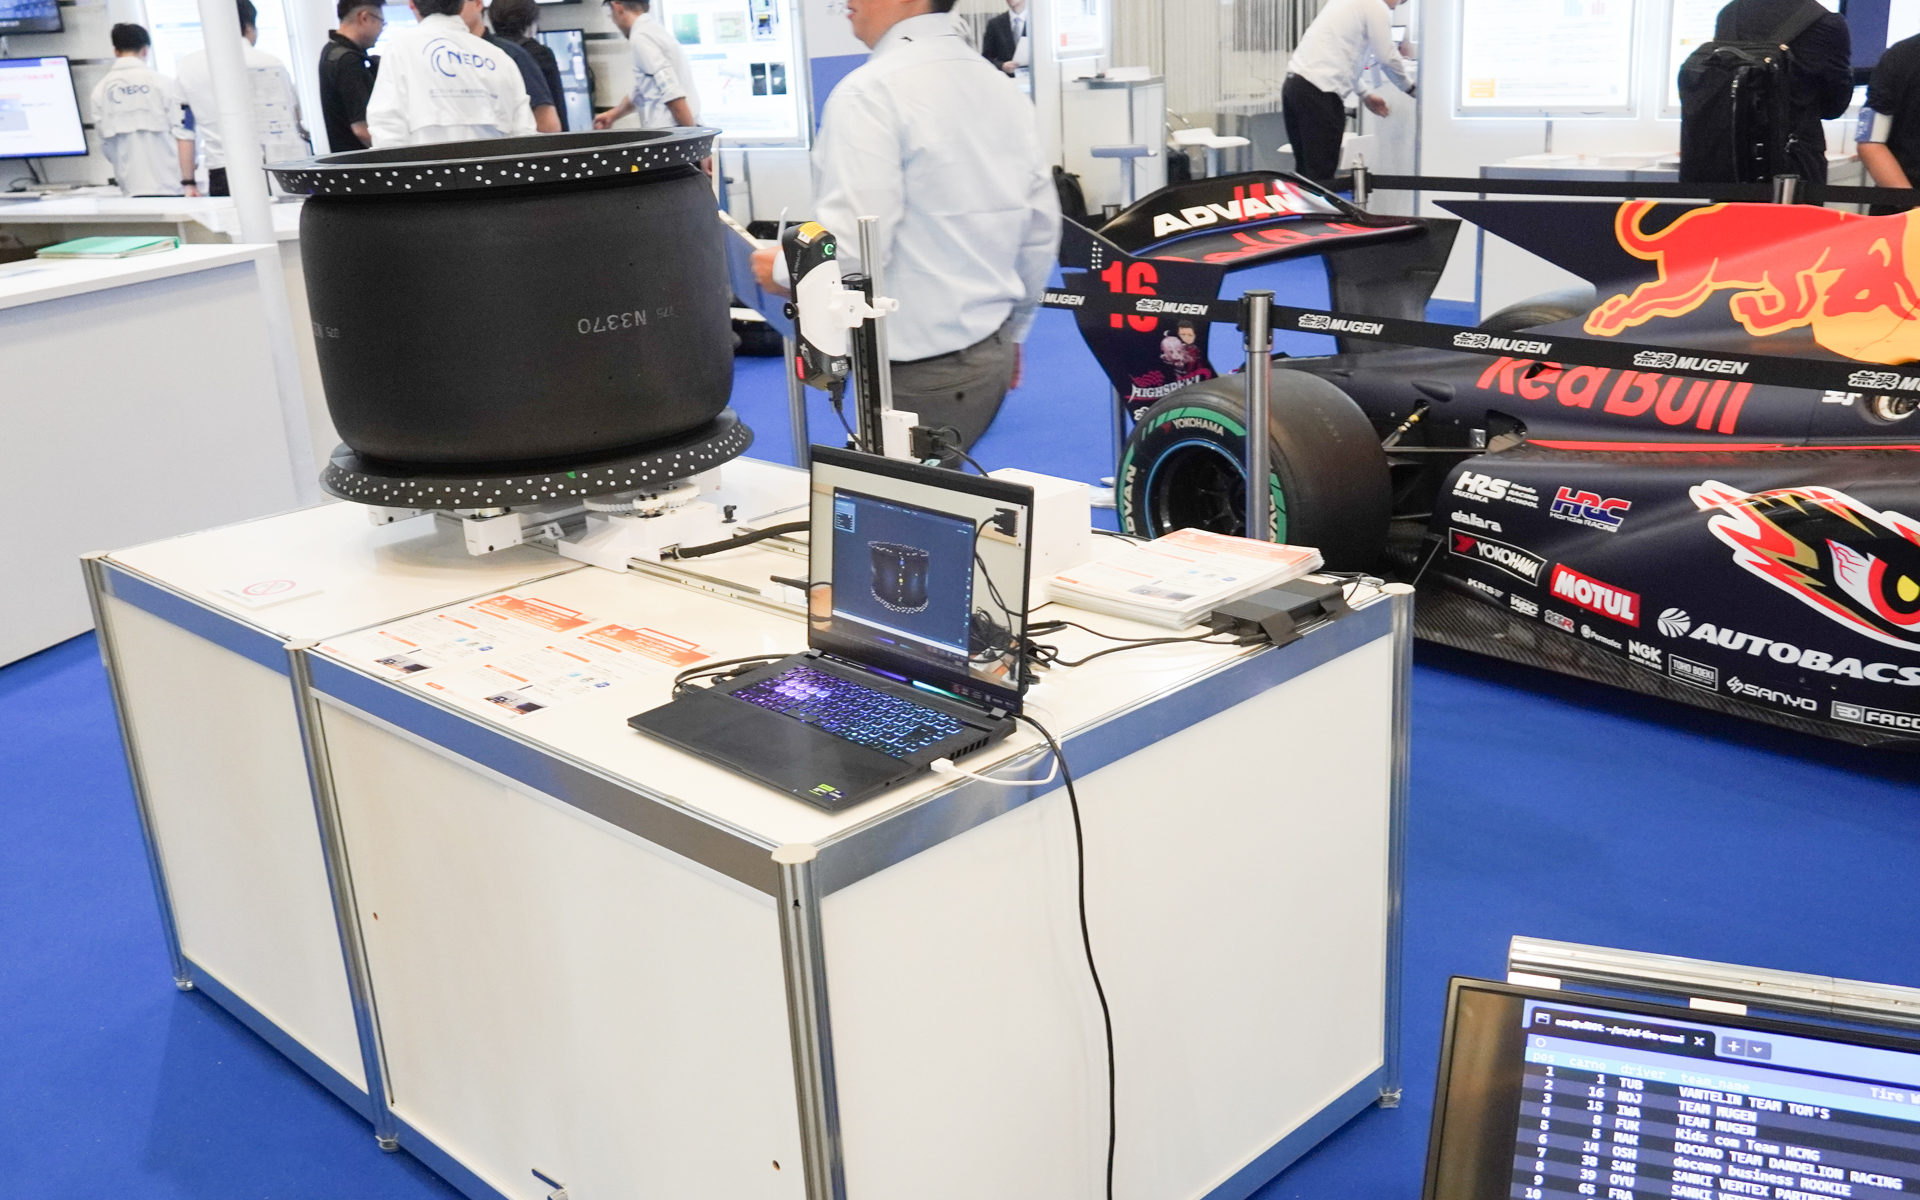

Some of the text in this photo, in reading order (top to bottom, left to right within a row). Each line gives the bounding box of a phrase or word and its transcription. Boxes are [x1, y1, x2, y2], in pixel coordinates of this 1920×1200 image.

[447, 51, 496, 71] NEDO
[1044, 293, 1085, 306] MUGEN
[1101, 261, 1158, 333] 16
[1163, 302, 1209, 316] MUGEN
[577, 309, 647, 334] N3370
[1330, 318, 1384, 336] MUGEN
[1489, 337, 1552, 355] MUGEN
[1675, 356, 1749, 375] MUGEN
[1604, 369, 1753, 435] Bull
[1172, 417, 1225, 437] YOKOHAMA
[1452, 489, 1489, 503] SUZUKA
[1454, 470, 1512, 500] HRS
[1508, 489, 1540, 502] RACING
[1124, 464, 1137, 535] DVAN
[1505, 495, 1539, 509] SCHOOL
[1550, 486, 1632, 527] HRC
[1450, 510, 1502, 533] dallara
[1549, 511, 1619, 533] Honda RACING
[1476, 541, 1540, 579] YOKOHAMA
[1554, 570, 1636, 621] MOTUL
[1628, 639, 1662, 664] NGK
[1688, 622, 1920, 687] AUTOBACS
[1742, 683, 1818, 712] SANYO
[1866, 711, 1920, 730] FAC
[1532, 1051, 1750, 1092] pos carno driver team_name
[1544, 1080, 1757, 1123] 2 16 NOJ TEAM MUGEN
[1545, 1066, 1830, 1120] 1 1 TUB VANTELIN TEAM TOM'S
[1870, 1086, 1904, 1102] Tire
[1543, 1093, 1756, 1136] 3 15 IWA TEAM MUGEN
[1541, 1106, 1820, 1162] 4 8 FUK Kids com Team KCMG
[1538, 1134, 1852, 1197] 6 14 OSH docomo business ROOKIE
[1540, 1120, 1903, 1191] 5 5 MAK DOCOMO TEAM DANDELION RACING
[1534, 1174, 1634, 1200] 9 65 FRA
[1535, 1161, 1545, 1172] 8
[1580, 1168, 1597, 1181] 39
[1609, 1174, 1635, 1188] OYU
[1671, 1184, 1713, 1200] SANKI
[1537, 1147, 1842, 1200] 7 38 SAK SANKI VERTEX PARTN
[1525, 1187, 1542, 1200] 10
